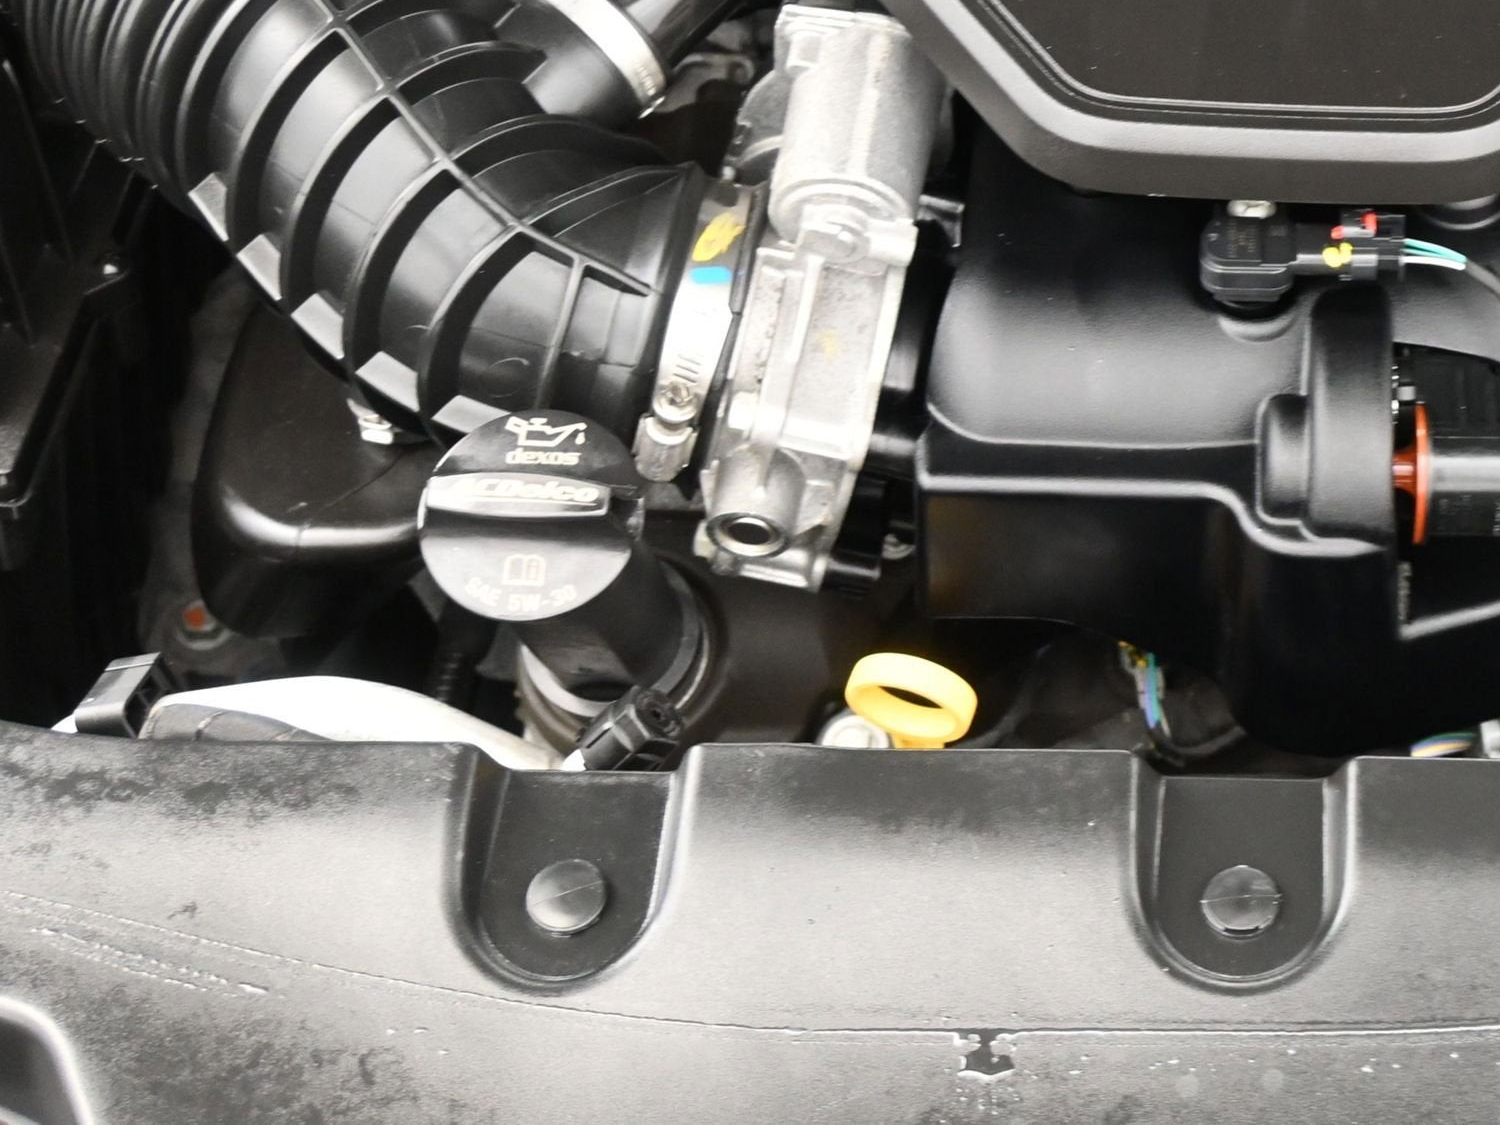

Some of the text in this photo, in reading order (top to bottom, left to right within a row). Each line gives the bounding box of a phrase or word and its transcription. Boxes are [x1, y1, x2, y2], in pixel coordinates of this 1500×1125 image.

[505, 448, 583, 465] dexos
[464, 576, 577, 612] SAE 5W-30
